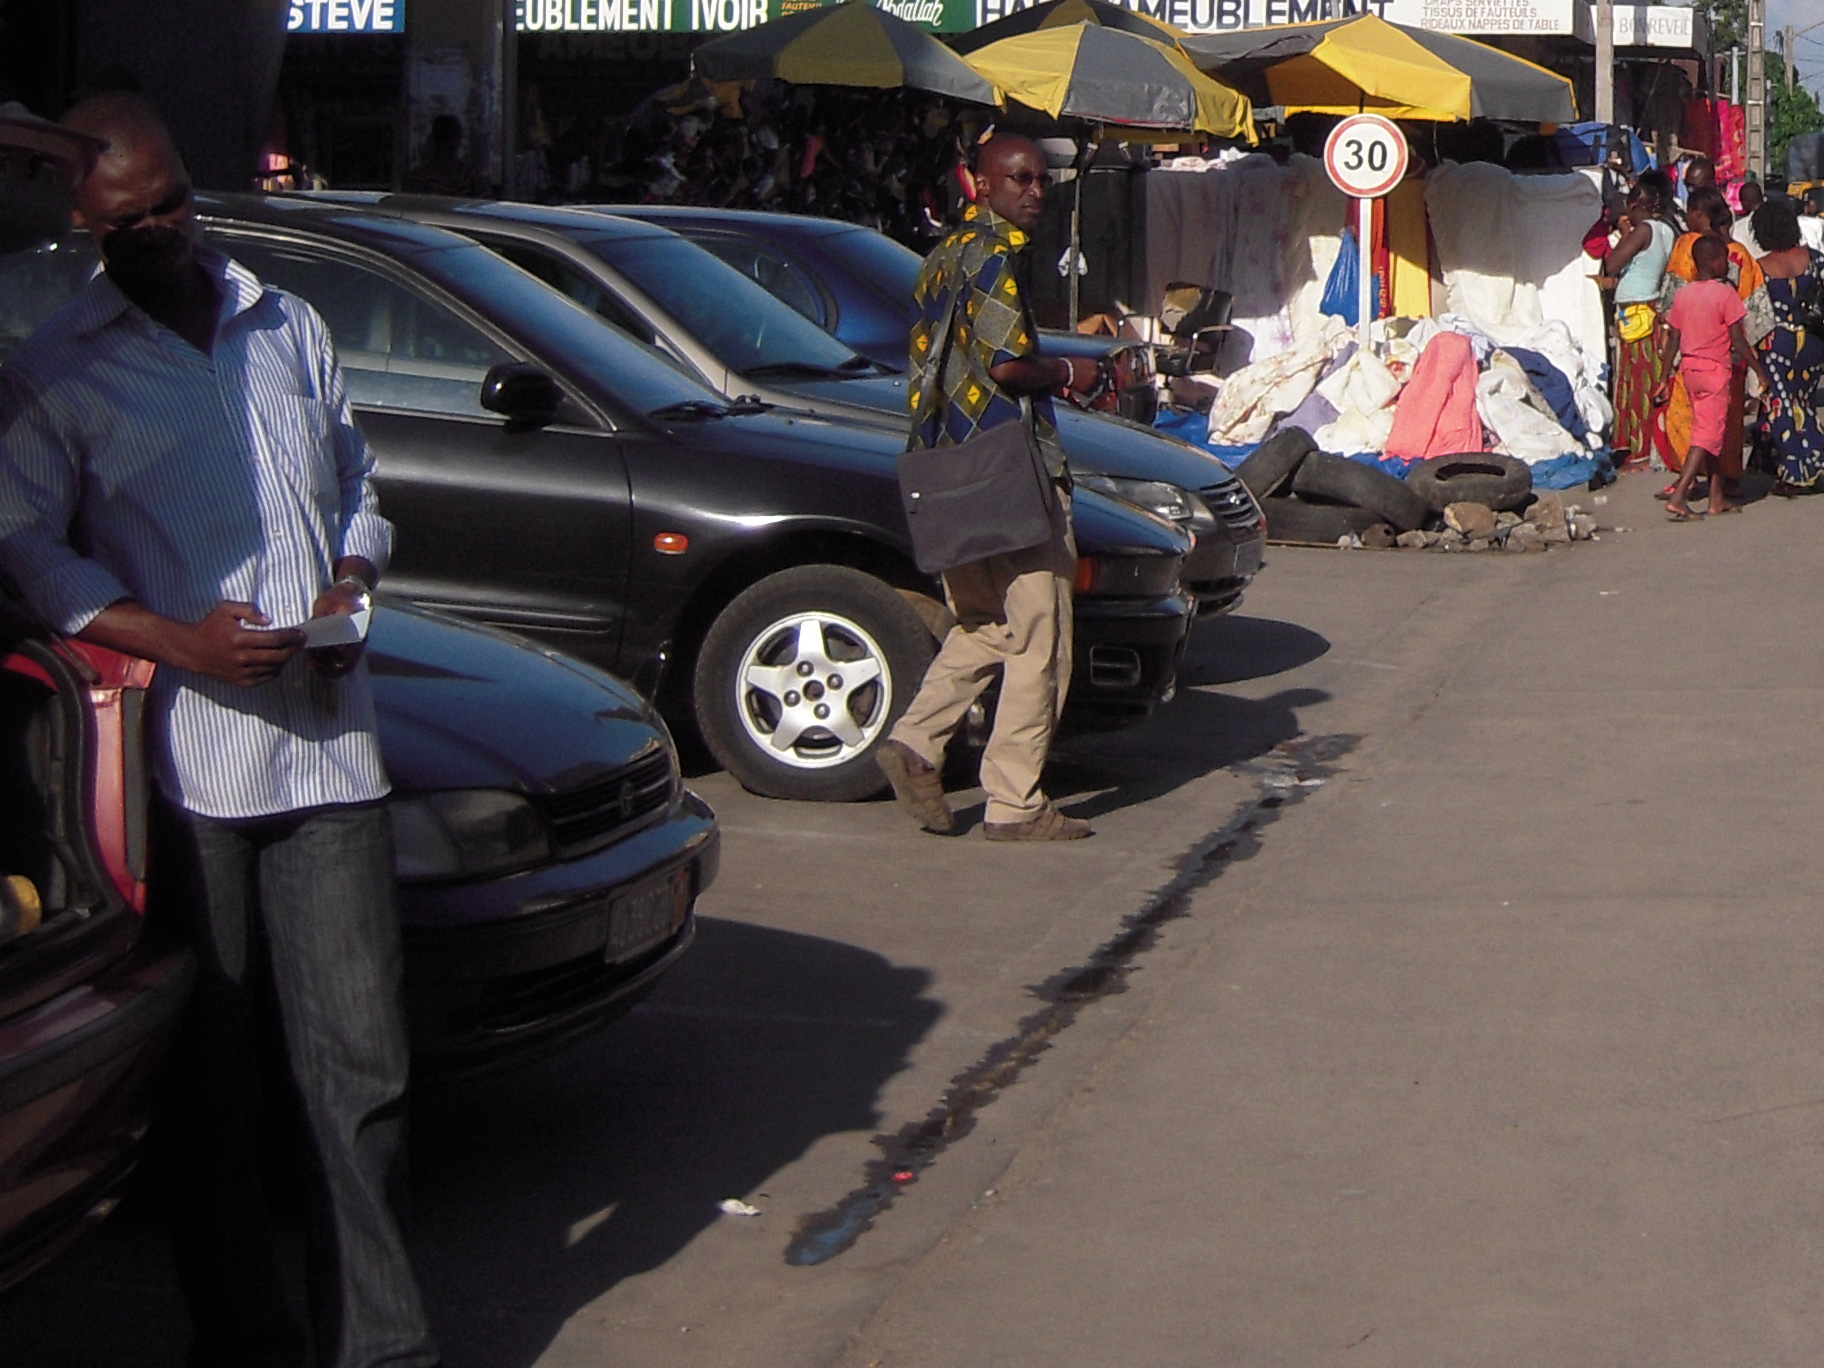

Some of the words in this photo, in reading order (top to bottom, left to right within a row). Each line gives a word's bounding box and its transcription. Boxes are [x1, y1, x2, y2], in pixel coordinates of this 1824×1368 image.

[1423, 6, 1462, 18] TISSUS
[1465, 7, 1478, 18] DE
[1480, 7, 1538, 18] FAUTEUILS
[1420, 18, 1465, 30] RIDEAUX
[1468, 18, 1510, 30] NAPPES
[1512, 19, 1525, 30] DE
[1528, 19, 1560, 31] TABLE
[1343, 139, 1388, 172] 30
